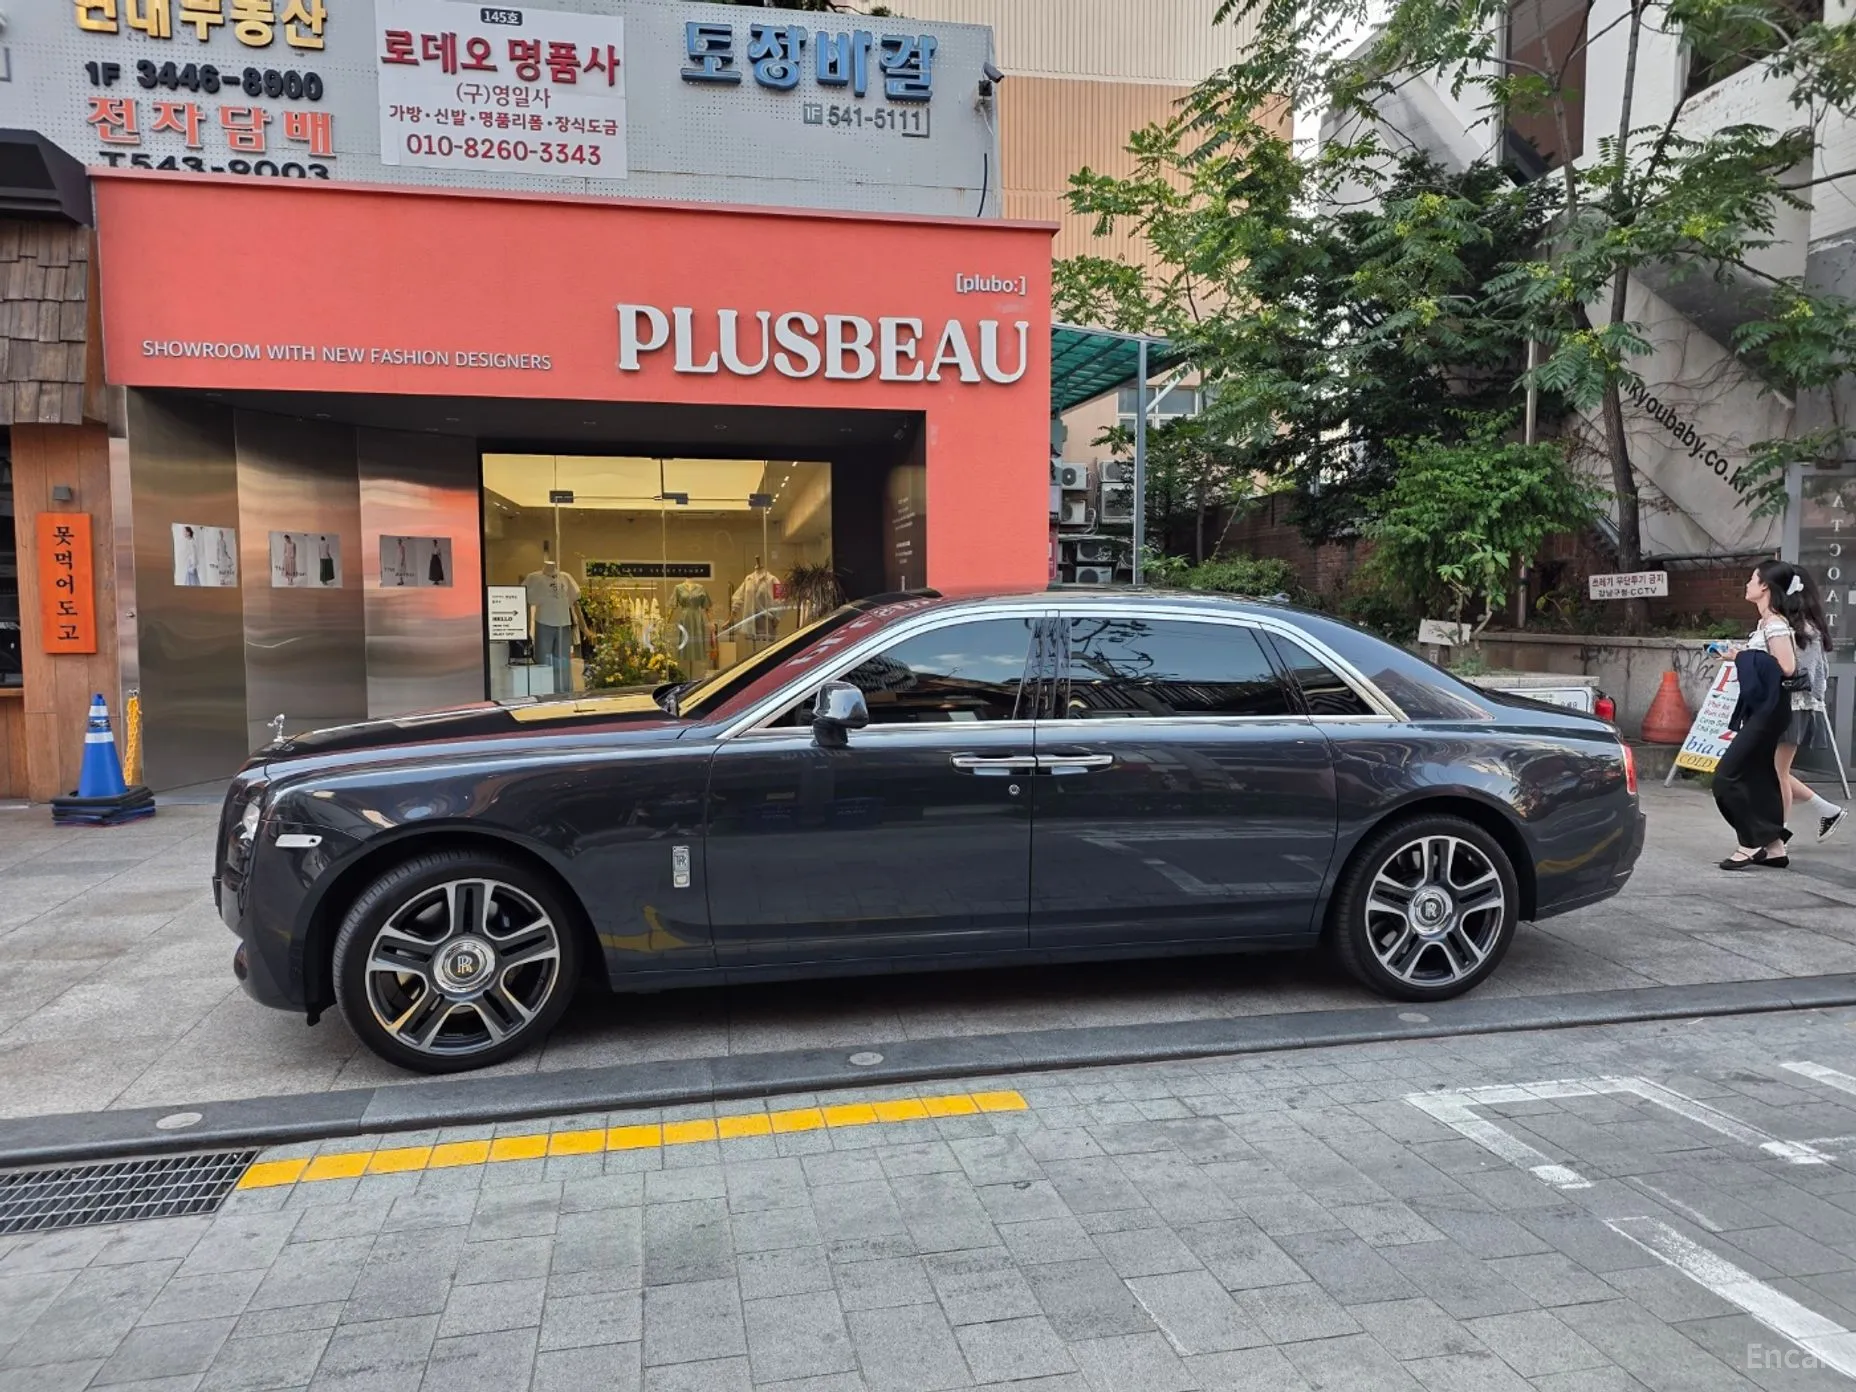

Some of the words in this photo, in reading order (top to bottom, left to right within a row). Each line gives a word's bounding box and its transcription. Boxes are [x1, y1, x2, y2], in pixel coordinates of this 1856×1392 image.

[483, 10, 520, 25] 145호
[381, 30, 498, 75] 로데오
[508, 39, 620, 87] 명품사
[680, 21, 938, 101] 토정비결
[86, 61, 120, 86] 1F
[137, 60, 323, 100] 3446-8900
[456, 83, 551, 109] (구)영일사
[87, 97, 335, 158] 전자담배
[828, 106, 921, 131] 541-5111
[406, 133, 602, 166] 010-8260-3343
[142, 340, 261, 359] SHOWROOM
[267, 344, 315, 362] WITH
[322, 346, 365, 364] NEW
[370, 348, 449, 367] FASHION
[455, 351, 552, 370] DESIGNERS
[616, 303, 1030, 384] PLUSBEAU
[52, 526, 80, 641] 못먹어도고
